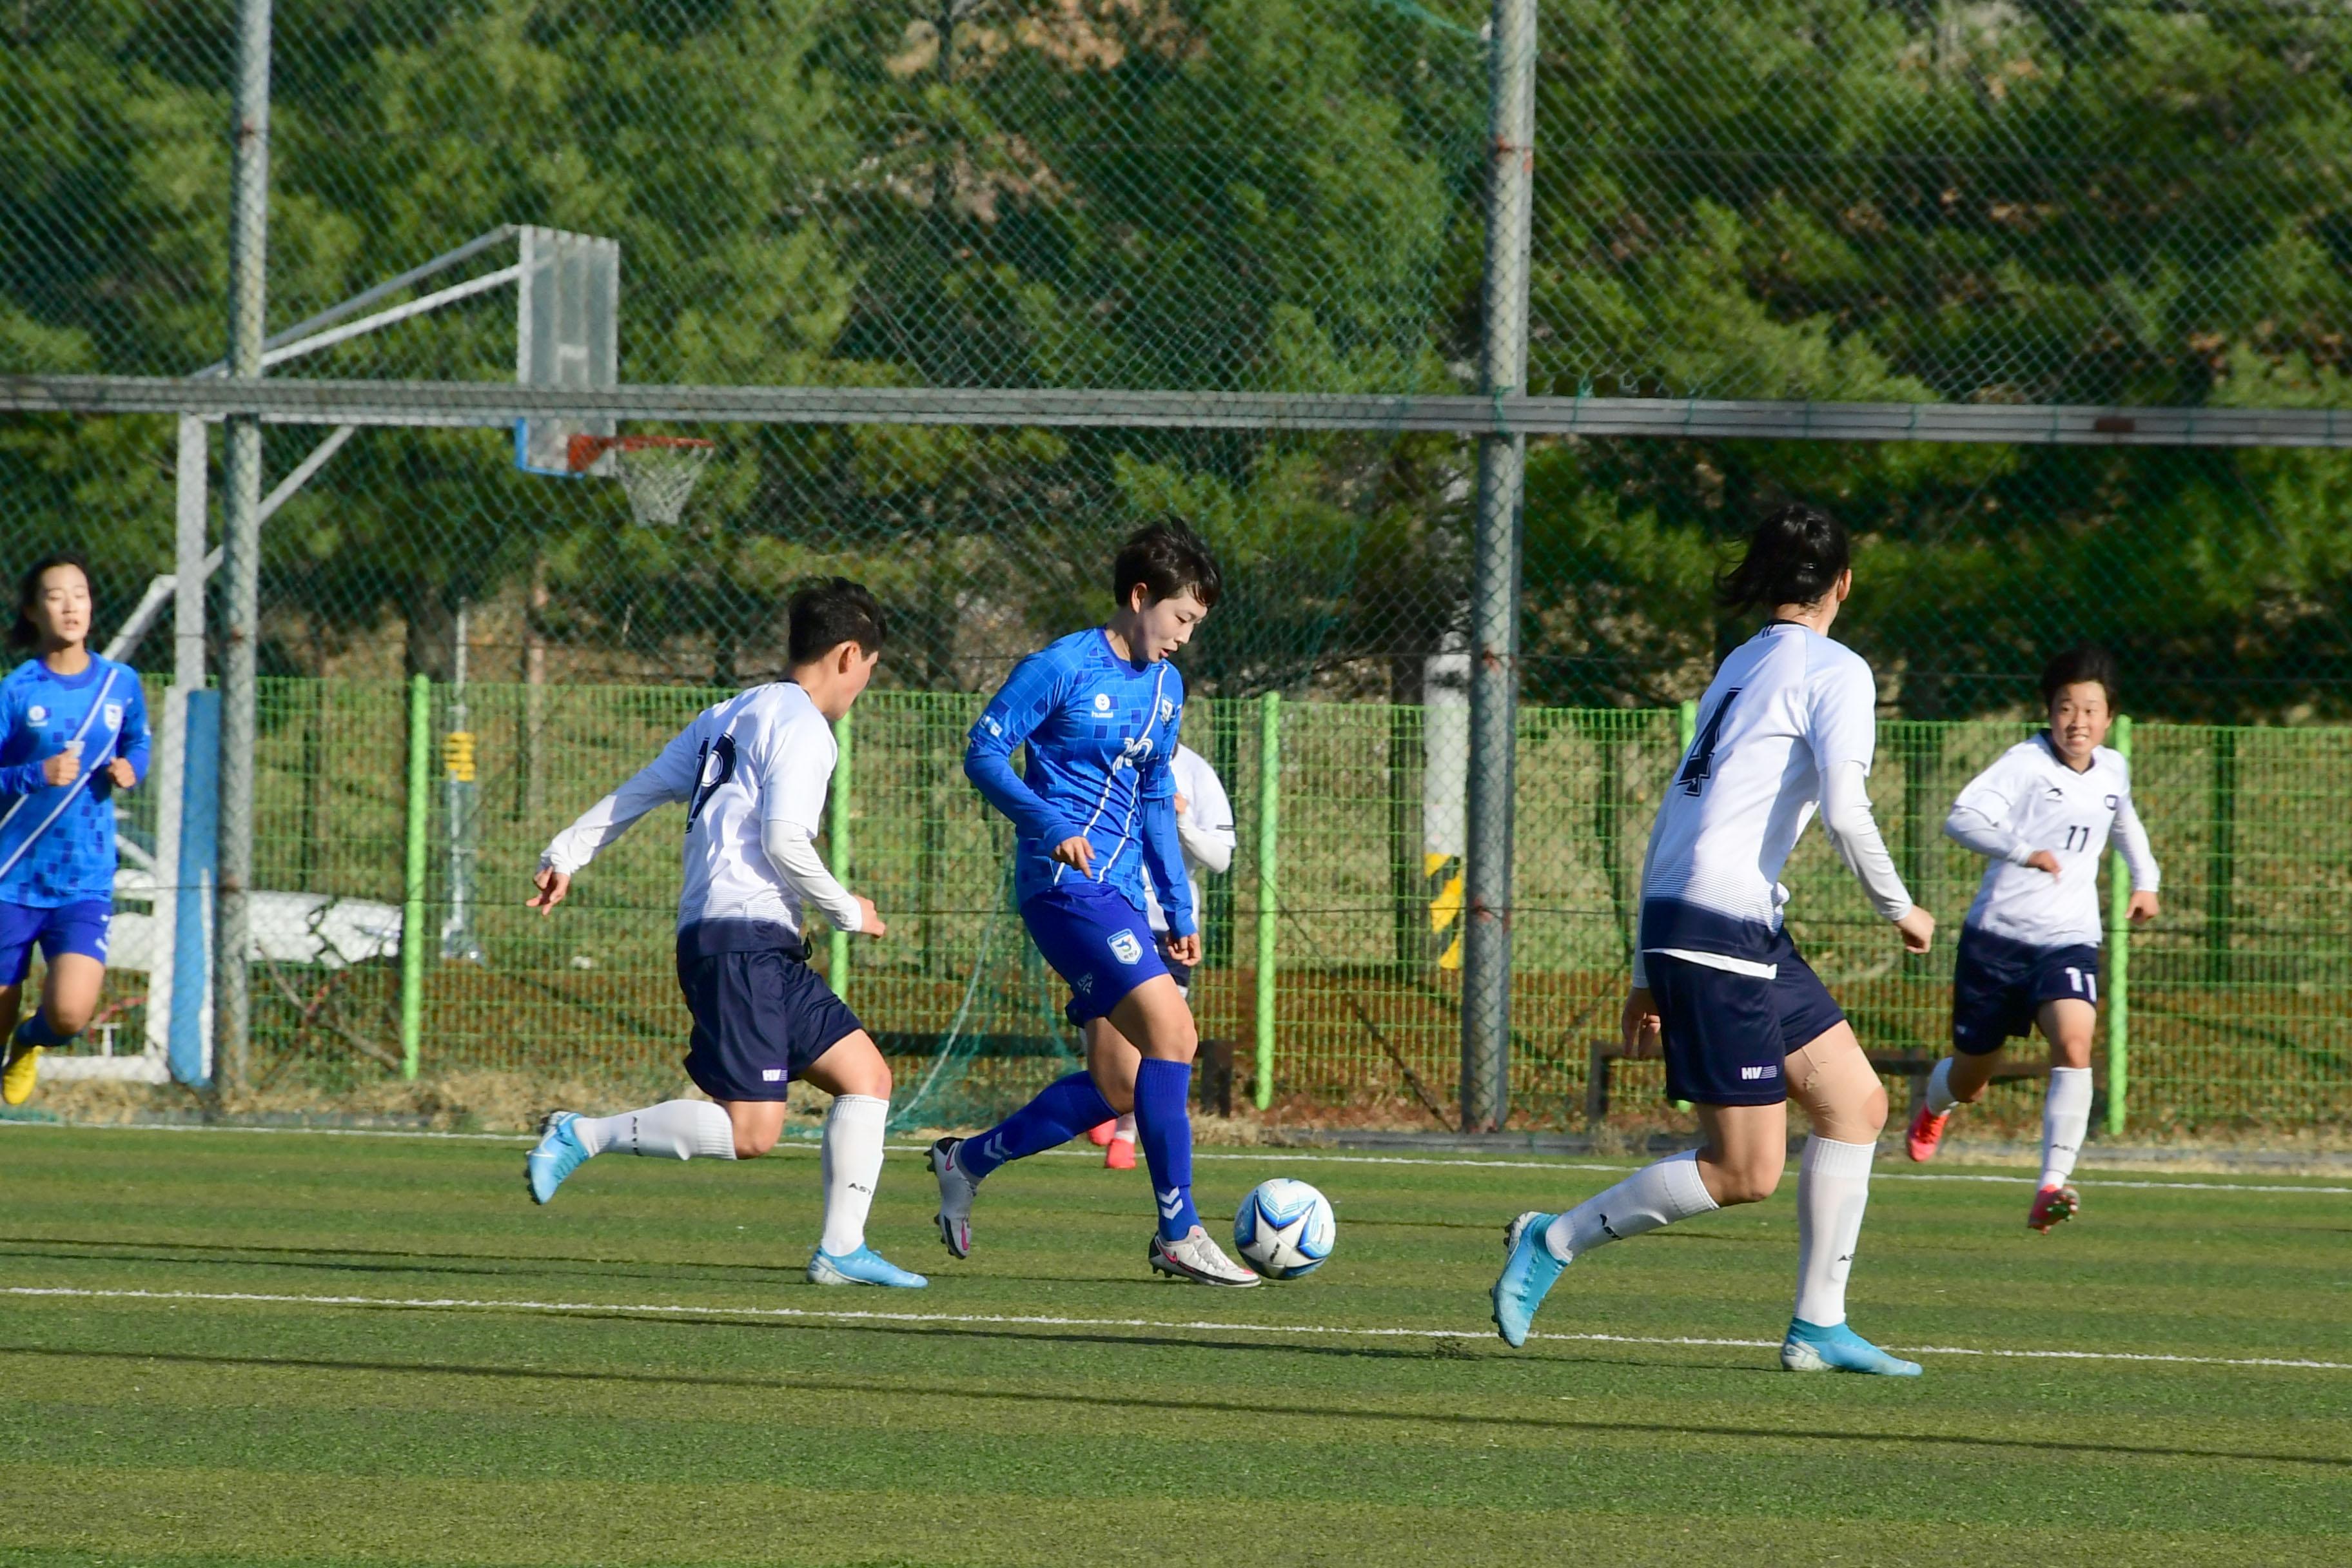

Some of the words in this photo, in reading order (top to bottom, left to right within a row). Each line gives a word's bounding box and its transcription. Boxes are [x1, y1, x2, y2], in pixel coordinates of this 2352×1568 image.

[1676, 687, 1743, 798] 4
[2065, 825, 2090, 852] 11
[2065, 967, 2097, 1003] 11
[1741, 1066, 1763, 1080] HV
